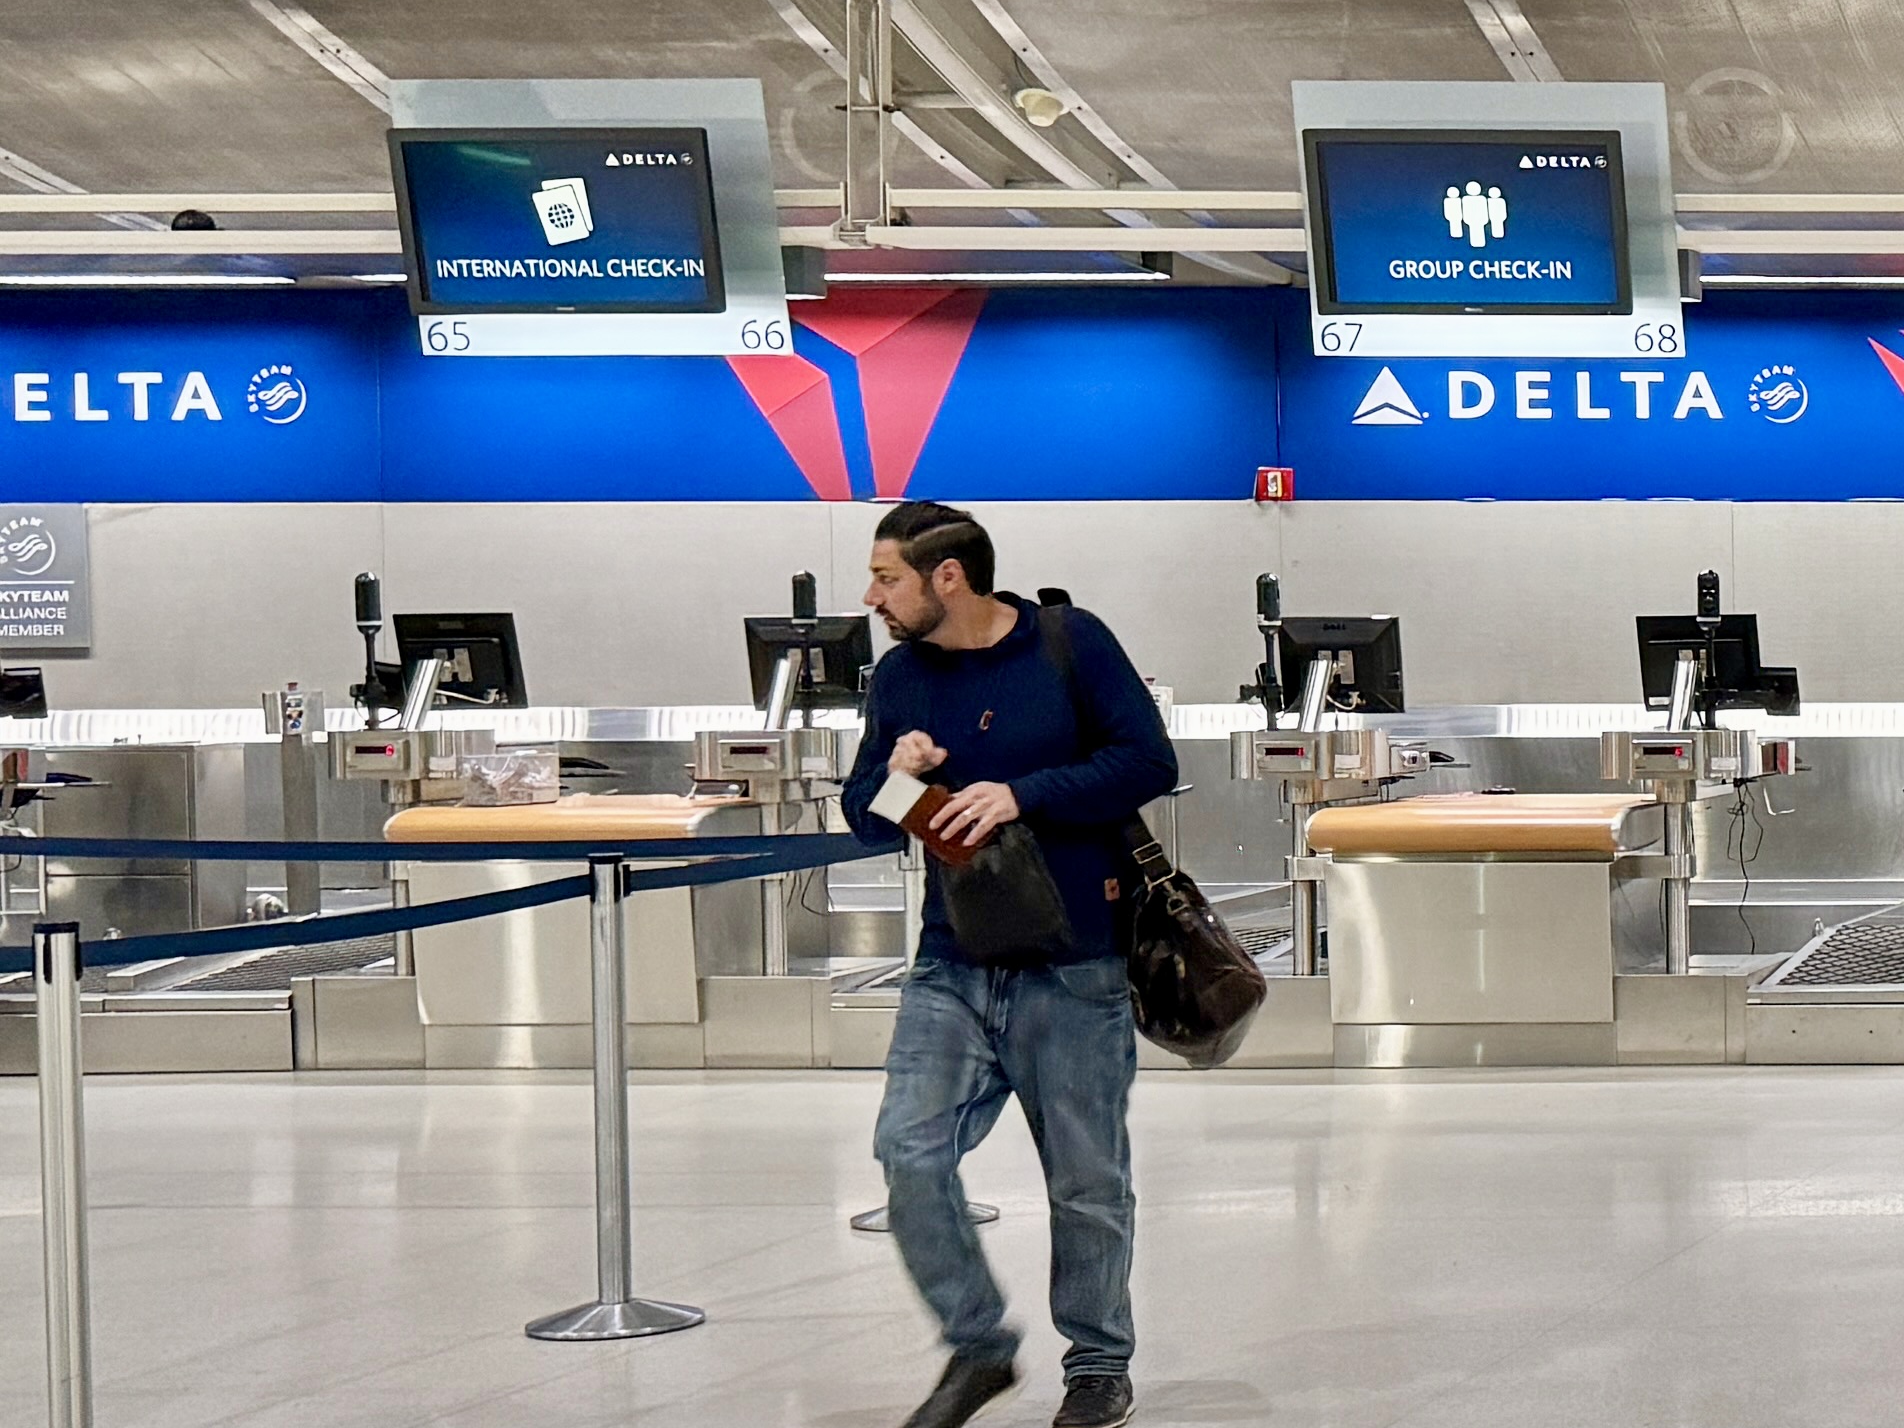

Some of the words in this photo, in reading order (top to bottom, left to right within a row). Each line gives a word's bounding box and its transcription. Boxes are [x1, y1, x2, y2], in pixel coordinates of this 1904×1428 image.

[622, 153, 678, 166] DELTA
[1535, 155, 1592, 169] DELTA
[436, 258, 603, 278] INTERNATIONAL
[606, 258, 705, 278] CHECK-IN
[1389, 259, 1464, 280] GROUP
[1468, 260, 1572, 280] CHECK-IN
[427, 321, 471, 352] 65
[741, 319, 785, 350] 66
[1320, 322, 1363, 353] 67
[1634, 323, 1678, 353] 68
[1447, 370, 1724, 420] DELTA
[0, 606, 67, 620] LLIANCE
